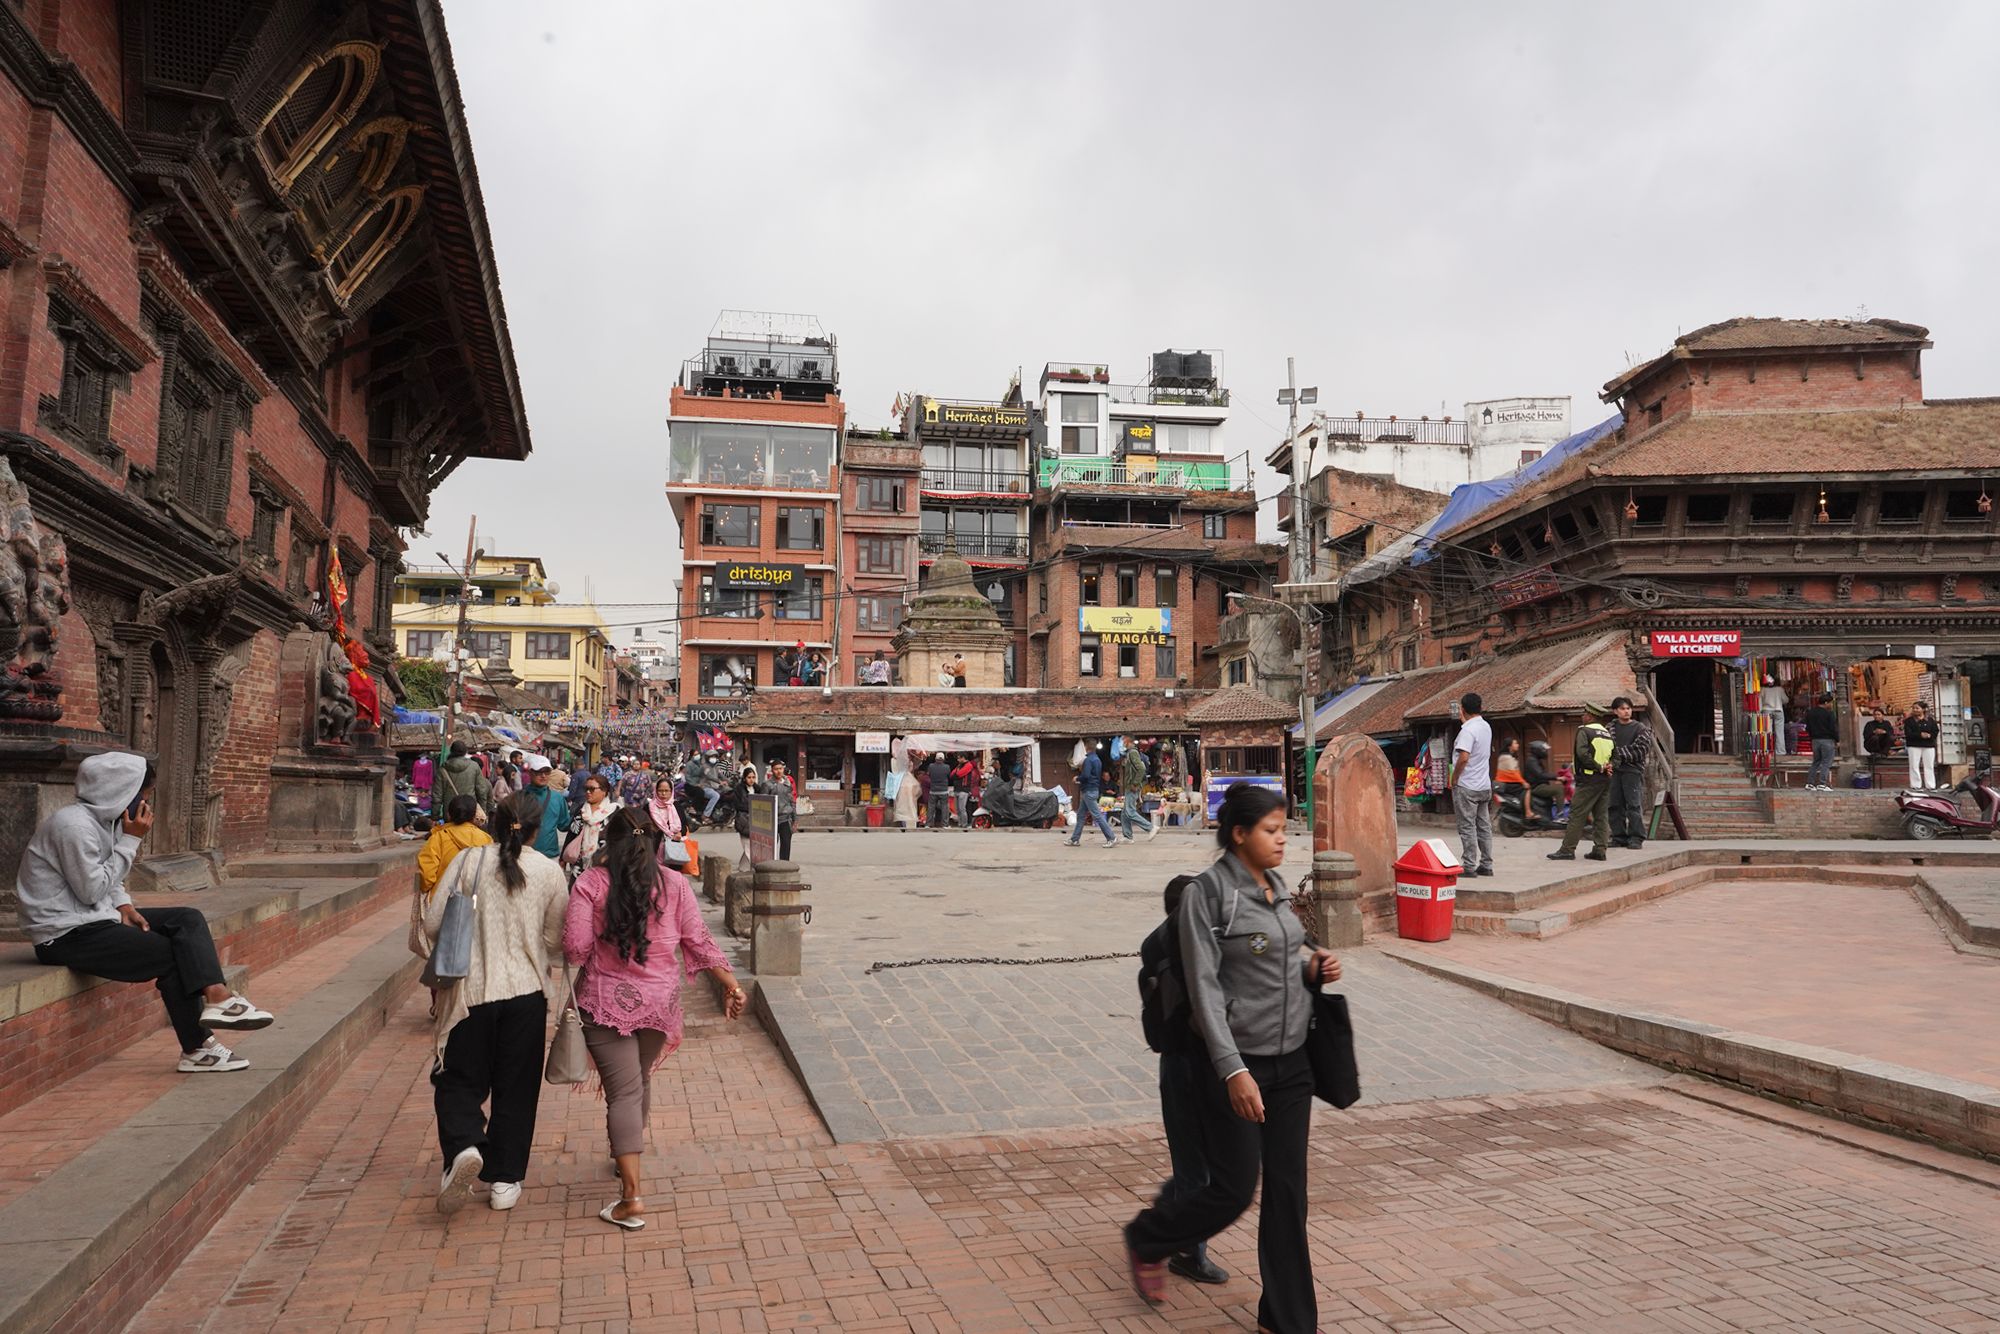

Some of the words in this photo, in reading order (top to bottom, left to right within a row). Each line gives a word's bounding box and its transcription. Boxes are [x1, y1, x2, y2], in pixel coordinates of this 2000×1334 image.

[945, 410, 993, 426] Heritage
[995, 412, 1027, 425] Home
[1497, 411, 1536, 422] Heritage
[1537, 410, 1563, 421] Home
[729, 566, 792, 584] drishya
[1102, 633, 1166, 645] MANGALE
[1656, 634, 1687, 643] YALA
[1690, 634, 1737, 643] LAYEKU
[1670, 645, 1722, 653] KITCHEN
[1410, 888, 1429, 897] POLICE
